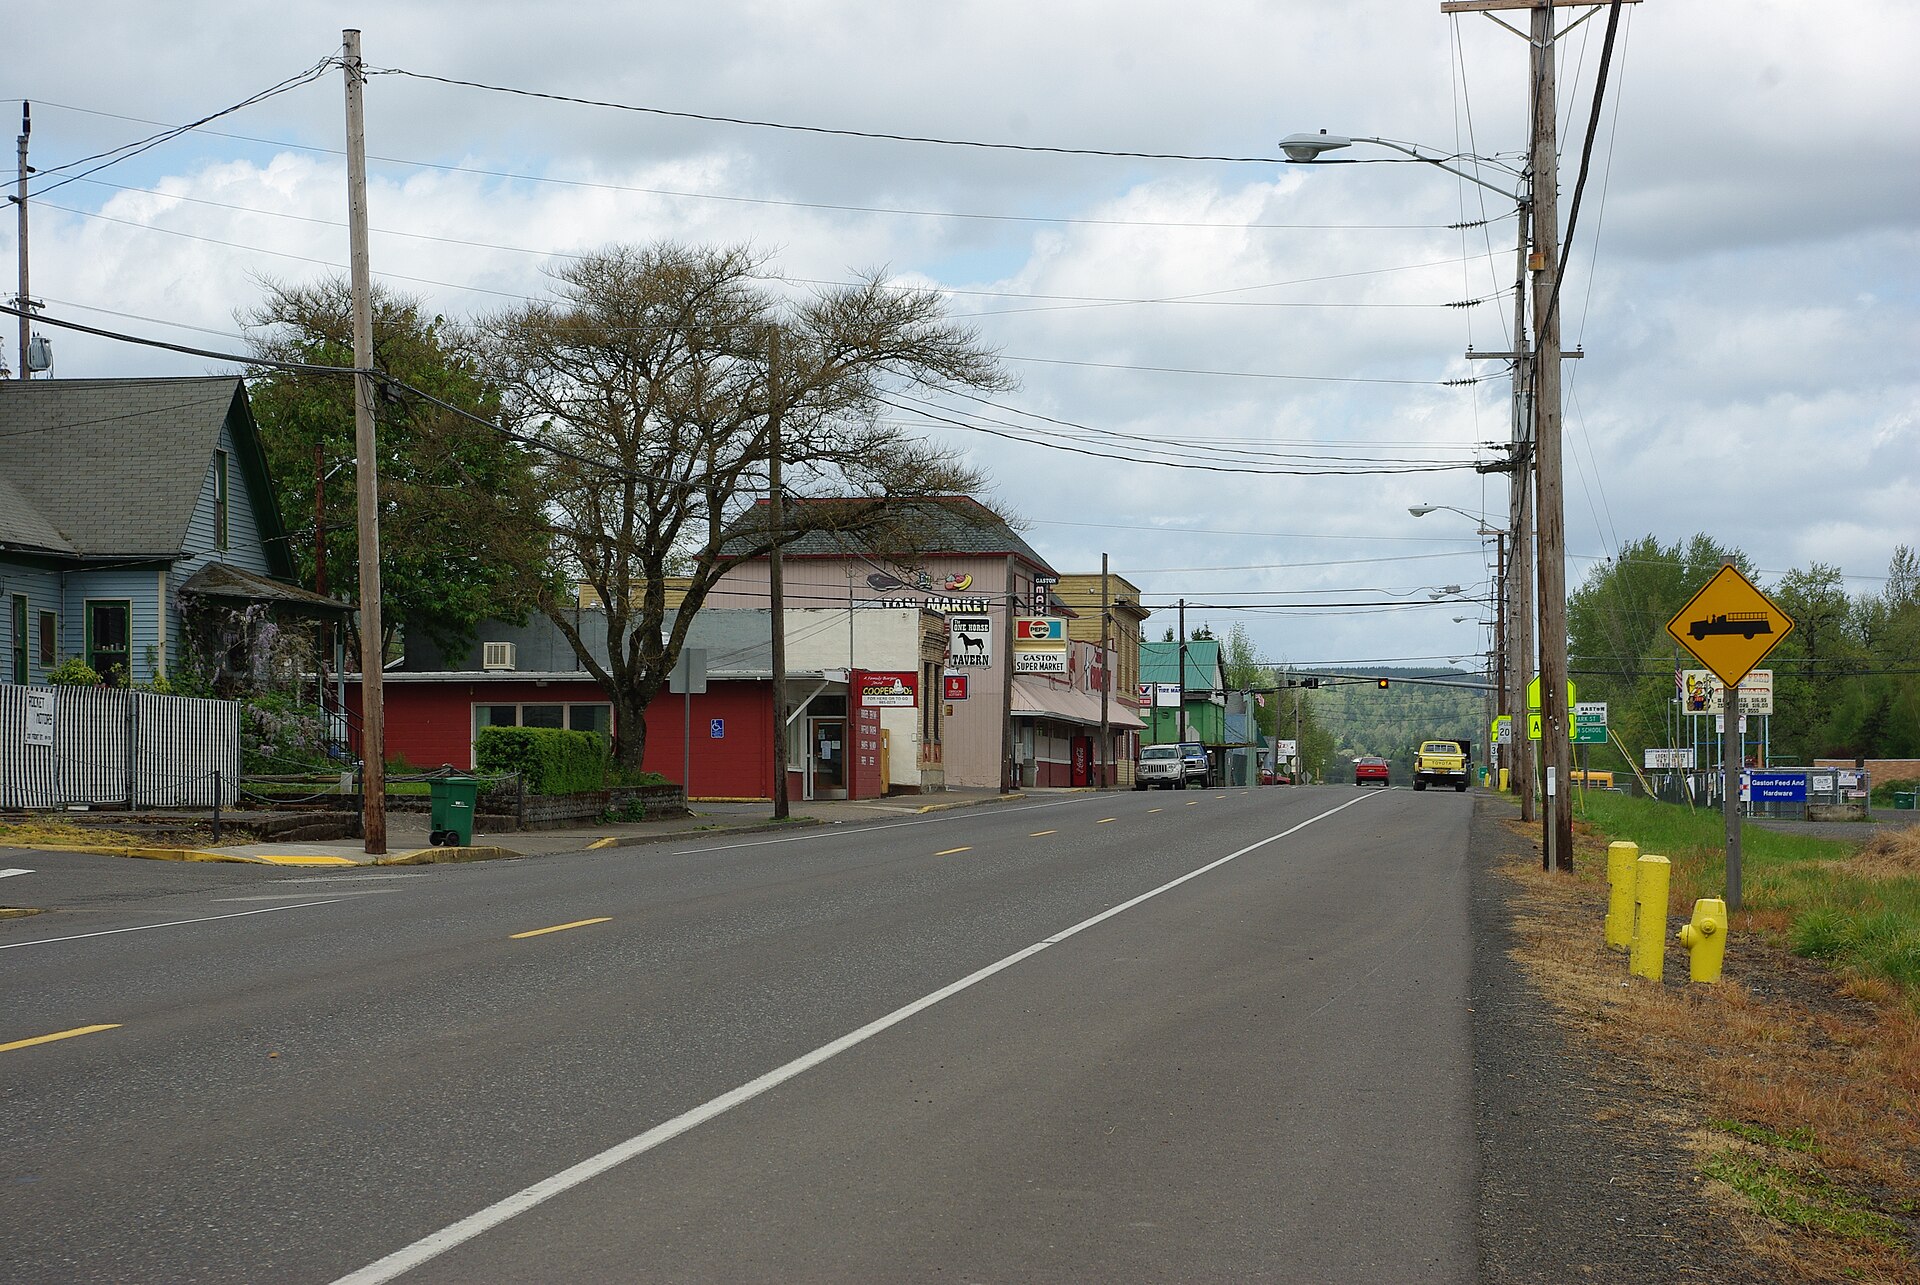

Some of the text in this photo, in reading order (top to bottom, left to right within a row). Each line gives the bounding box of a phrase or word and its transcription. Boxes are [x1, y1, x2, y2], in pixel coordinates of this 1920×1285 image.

[925, 596, 991, 613] MARKET
[952, 654, 989, 666] TAVERN
[1023, 654, 1058, 662] GASTON
[1016, 662, 1063, 671] SUPER MARKET
[863, 686, 895, 695] COOPER
[1499, 727, 1510, 737] 20
[1752, 779, 1774, 787] Gaston
